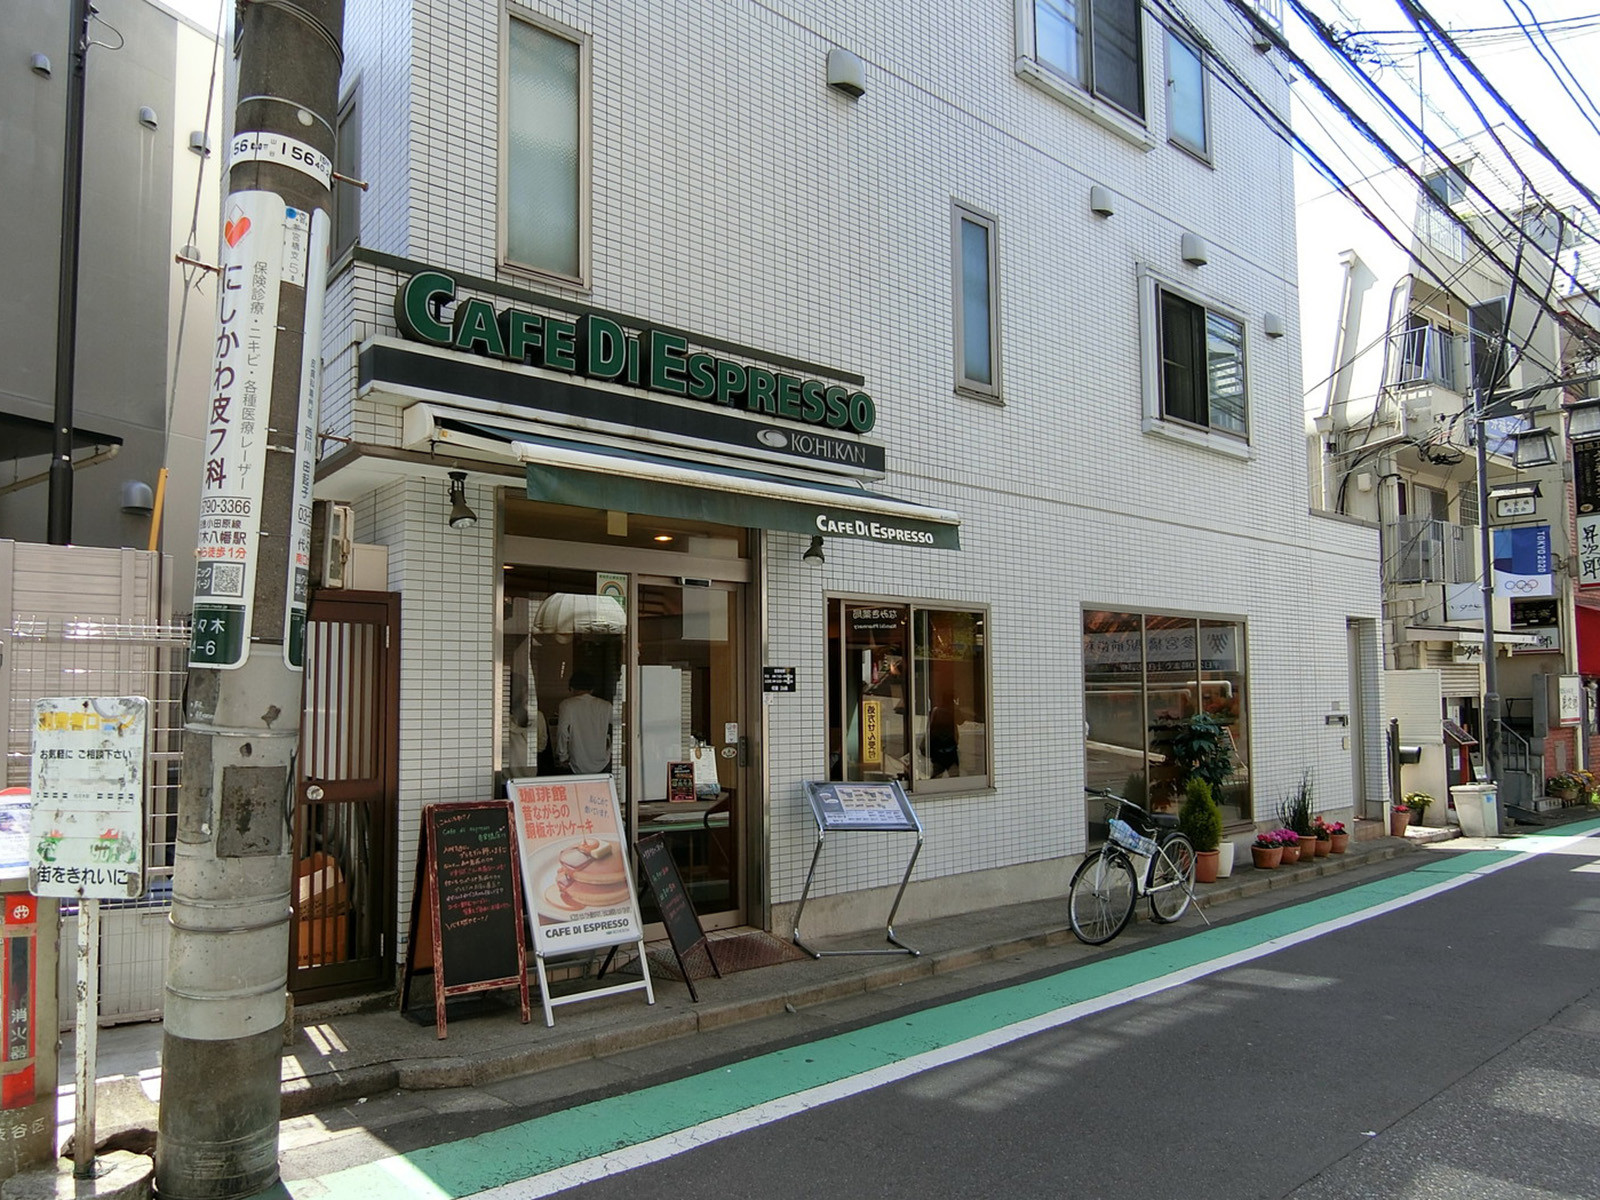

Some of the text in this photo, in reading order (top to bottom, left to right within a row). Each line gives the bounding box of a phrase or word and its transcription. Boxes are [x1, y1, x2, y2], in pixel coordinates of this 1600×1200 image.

[205, 263, 243, 489] にしかわ皮フ科
[816, 514, 854, 535] CAFE
[870, 522, 934, 544] ESPRESSO
[1536, 531, 1547, 573] TOKYO 2020
[518, 786, 568, 803] 珈琲館
[522, 803, 570, 821] 昔ながらの
[37, 865, 128, 885] 街をきれいに
[545, 926, 571, 938] CAFE
[573, 925, 582, 934] DI
[583, 918, 629, 933] ESPRESSO
[11, 1007, 27, 1060] 消火器
